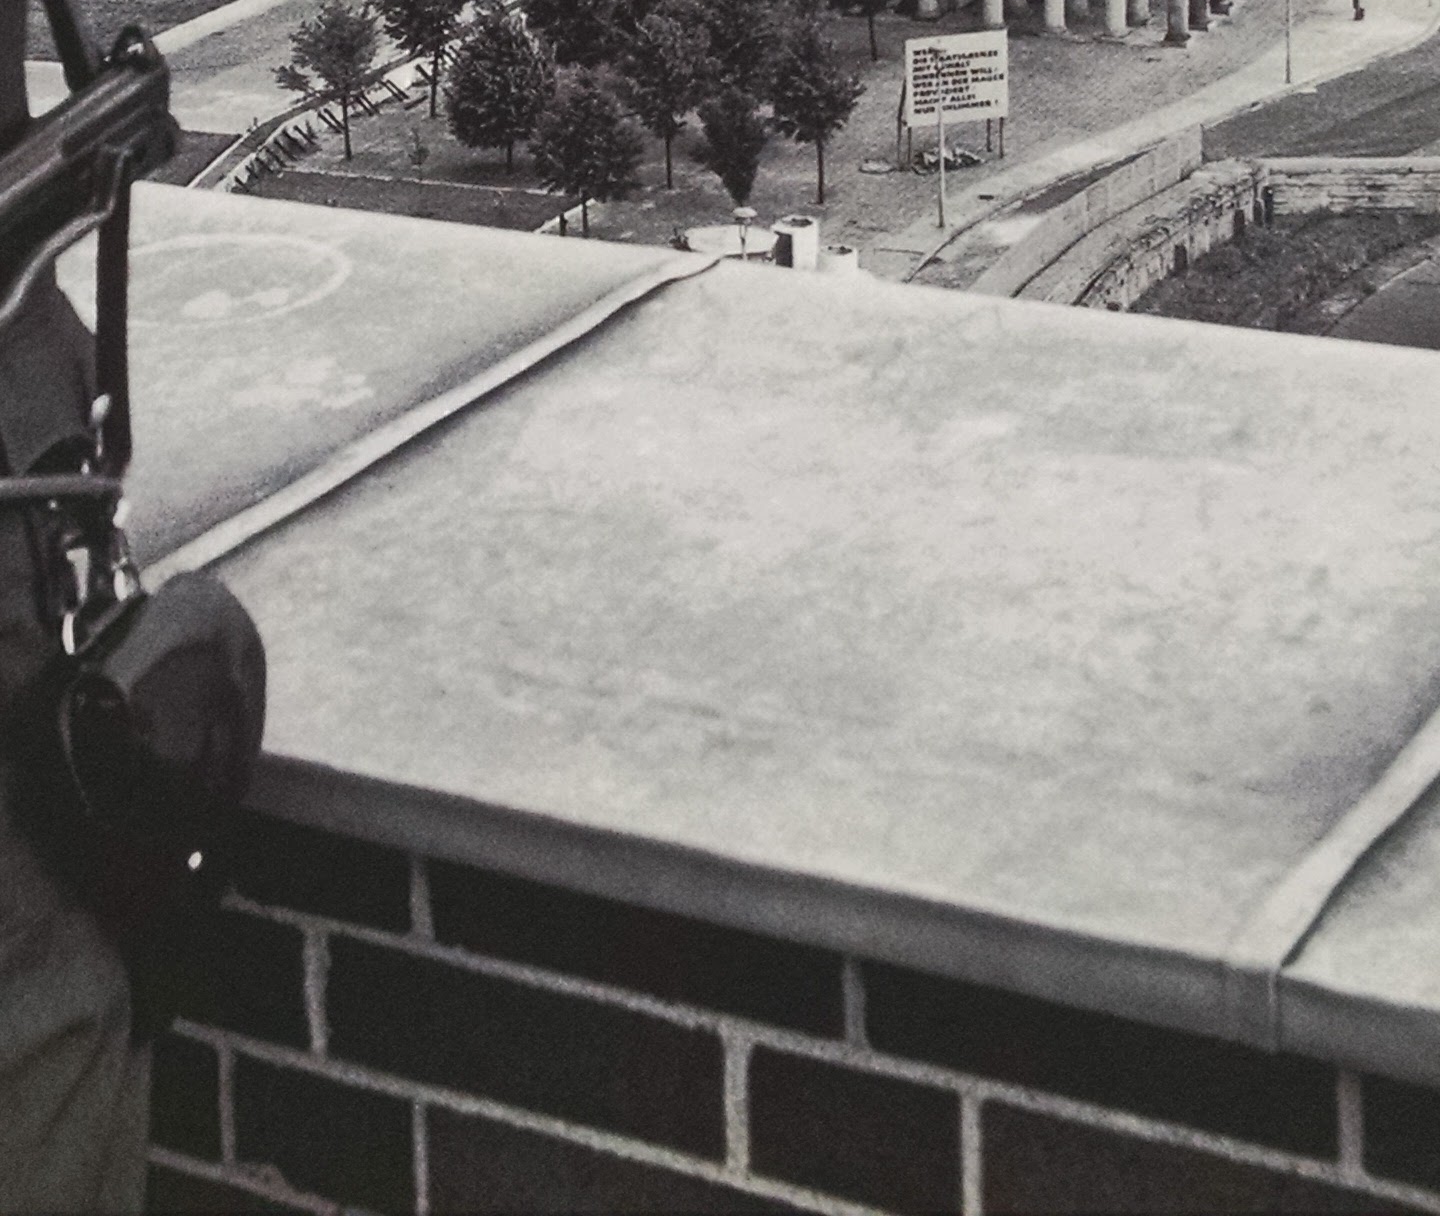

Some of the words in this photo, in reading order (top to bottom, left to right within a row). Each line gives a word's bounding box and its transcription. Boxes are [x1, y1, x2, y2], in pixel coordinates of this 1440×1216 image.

[912, 81, 933, 89] WER
[951, 78, 968, 86] DER
[971, 73, 1004, 83] MAUER
[950, 93, 976, 102] ALLES
[913, 106, 936, 114] NUR
